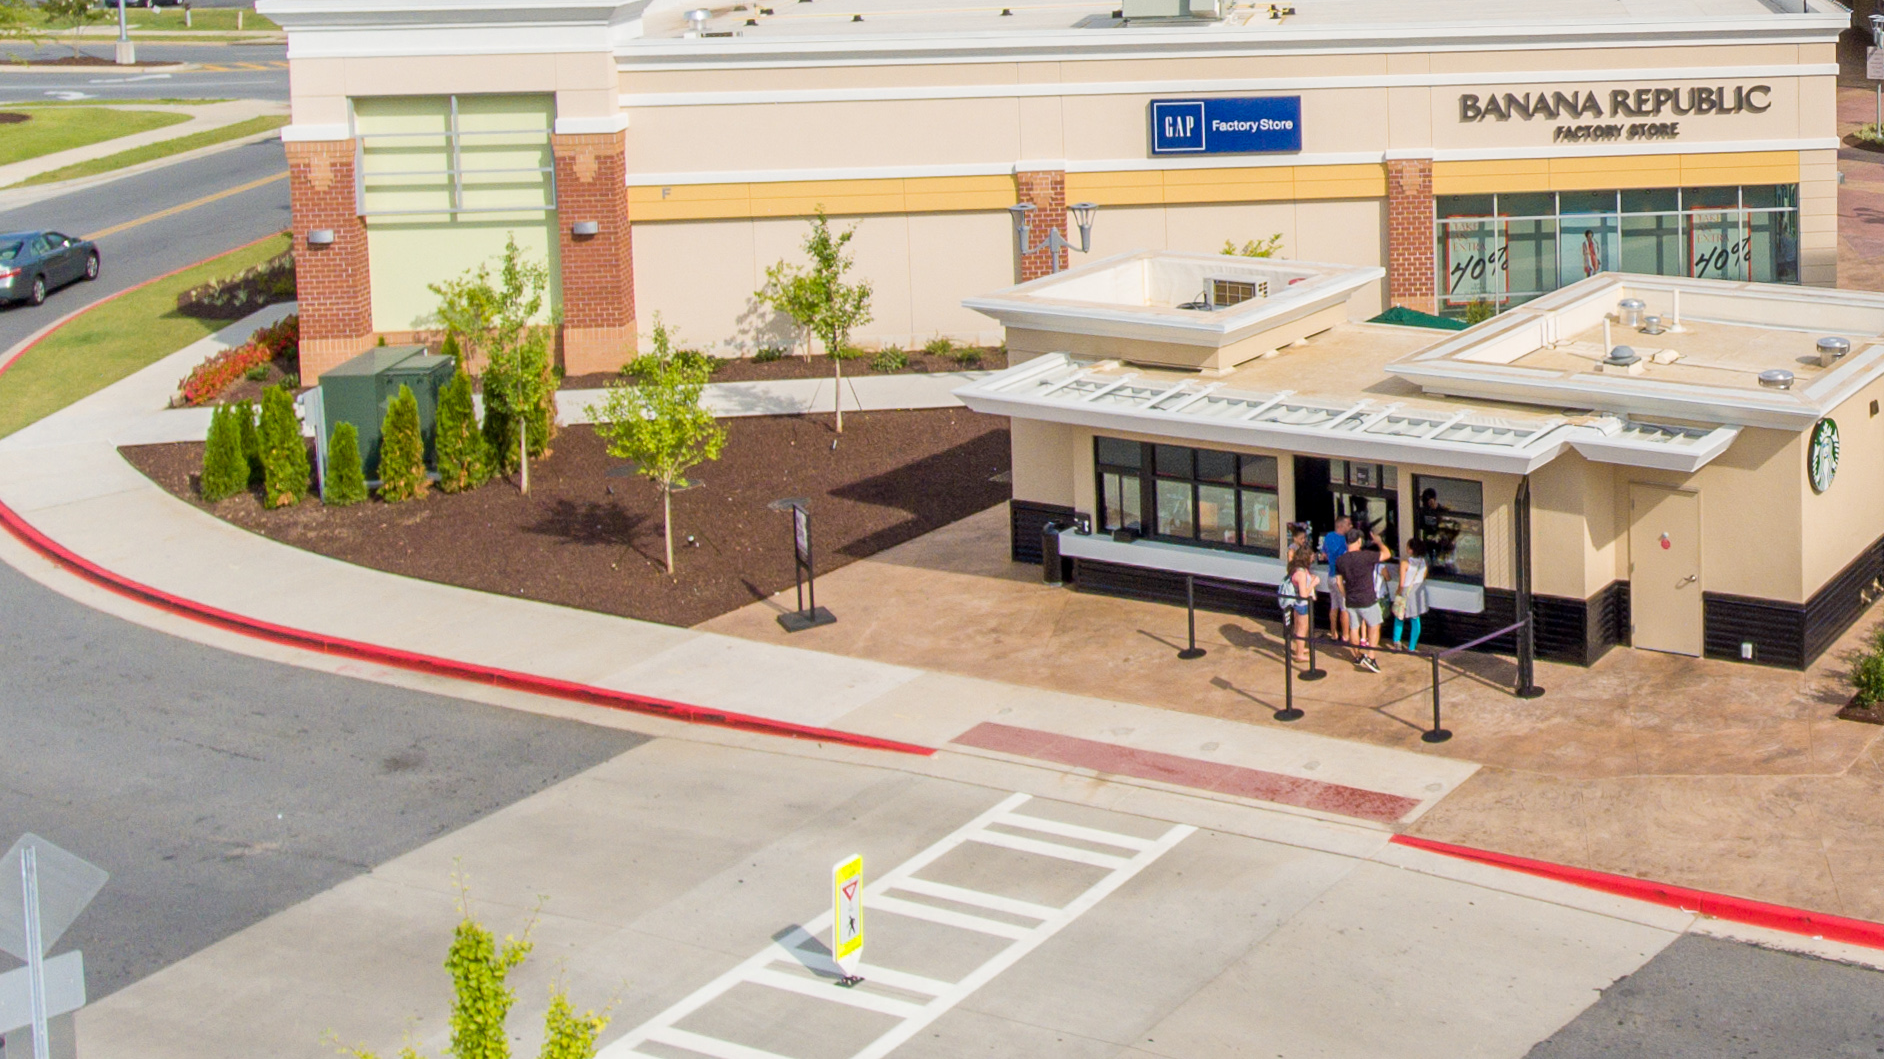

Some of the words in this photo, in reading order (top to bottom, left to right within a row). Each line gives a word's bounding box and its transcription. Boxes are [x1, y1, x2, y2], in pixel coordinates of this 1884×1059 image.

[1459, 89, 1604, 123] BANANA
[1610, 84, 1772, 118] REPUBLIC
[1165, 115, 1195, 138] GAP
[1212, 119, 1259, 133] Factory
[1260, 118, 1294, 131] Store
[1554, 123, 1625, 143] FACTORY
[1626, 121, 1680, 142] STORE
[1453, 222, 1478, 232] TAKE
[1697, 233, 1730, 244] EXTRA
[1452, 242, 1487, 252] EXTRA
